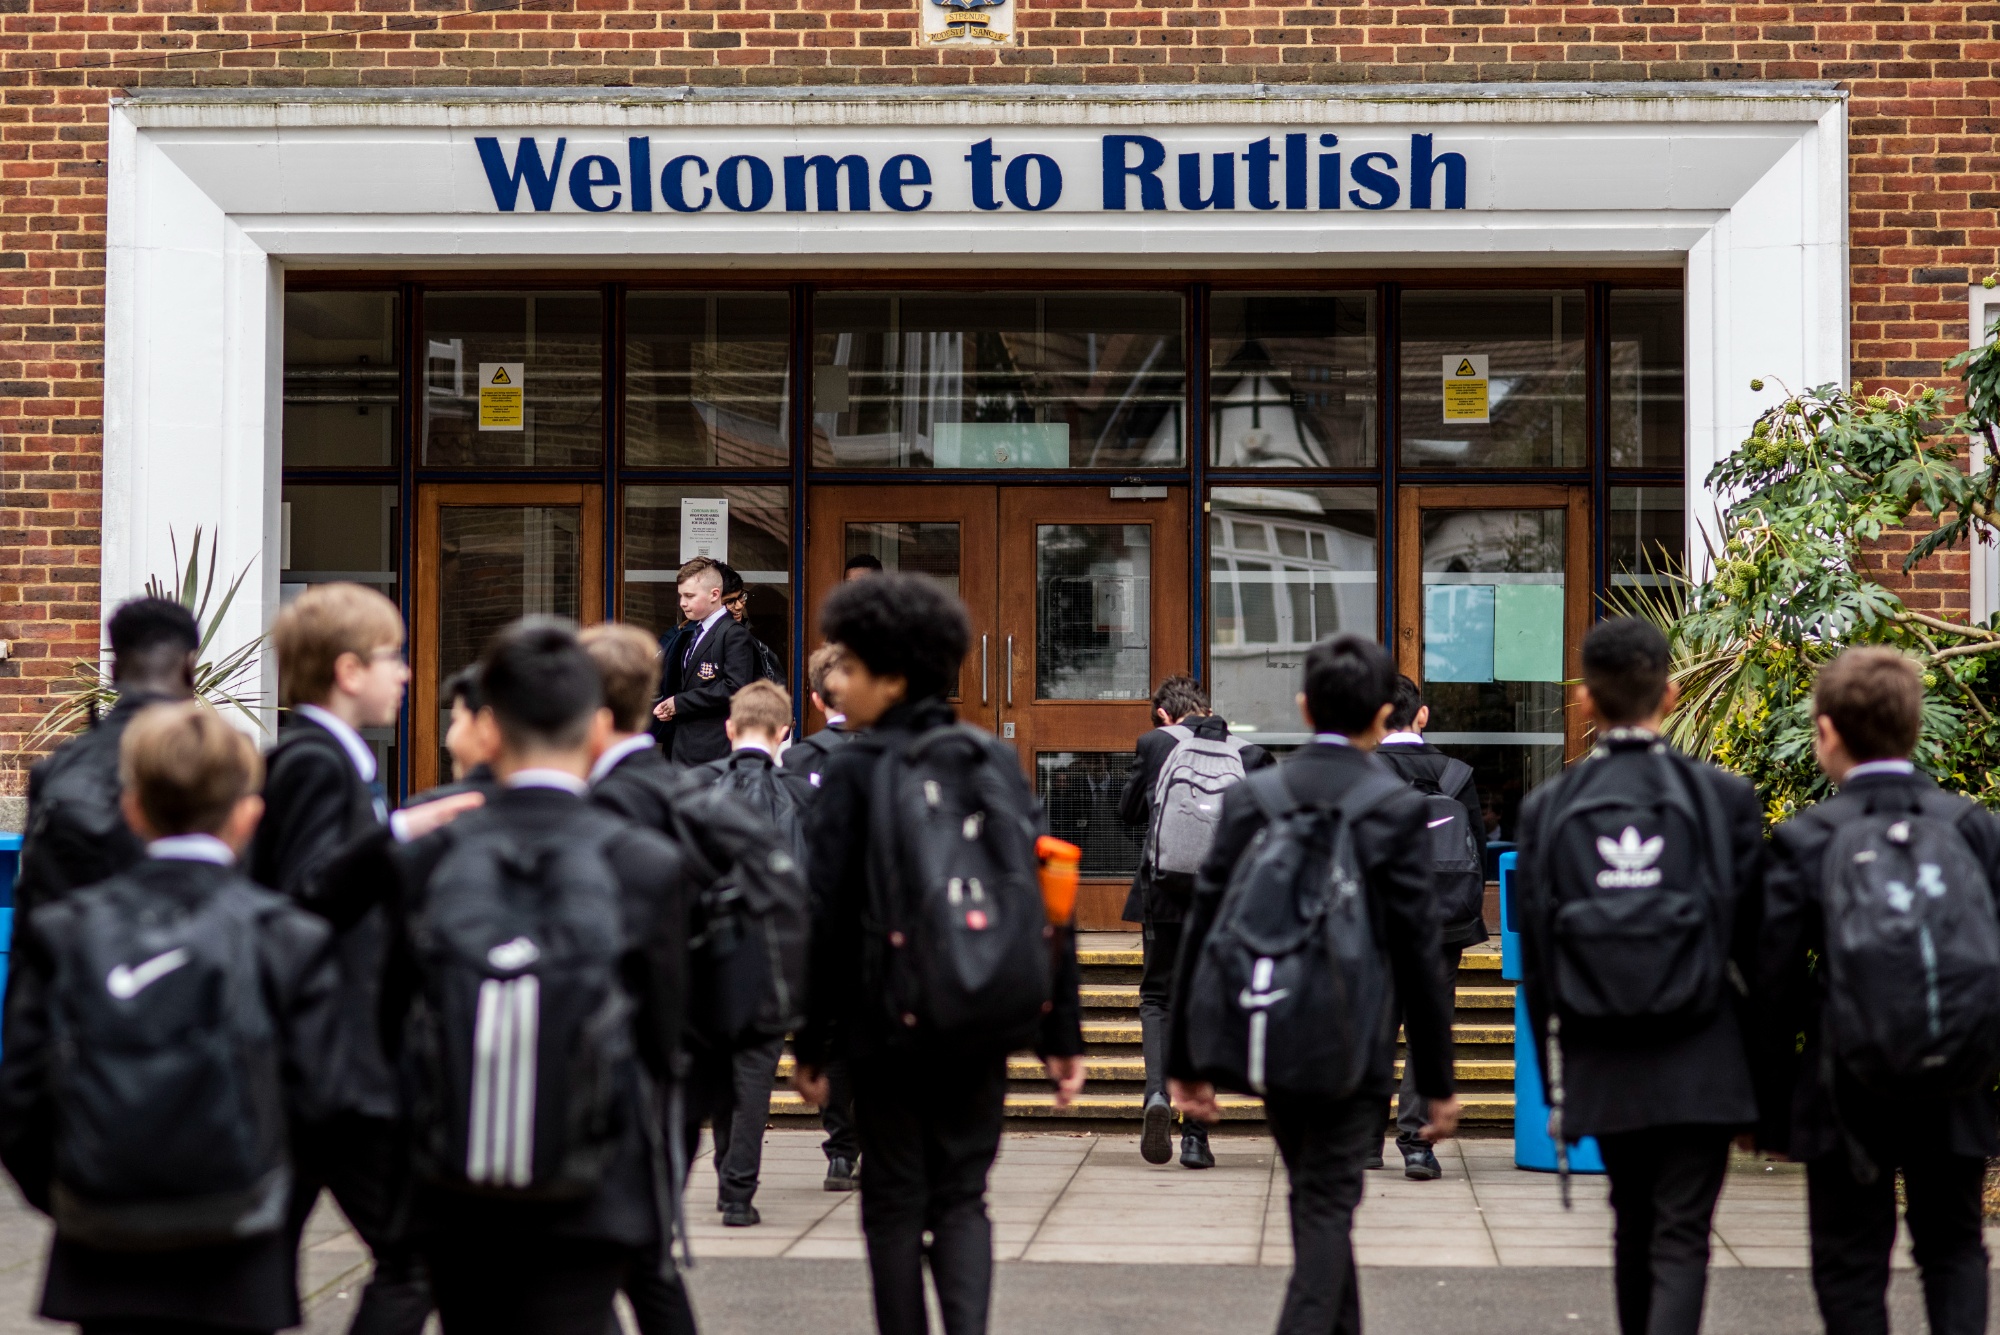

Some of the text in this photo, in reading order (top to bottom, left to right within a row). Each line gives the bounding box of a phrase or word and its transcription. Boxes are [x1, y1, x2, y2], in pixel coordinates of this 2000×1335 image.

[474, 132, 1467, 212] Welcome to Rutlish
